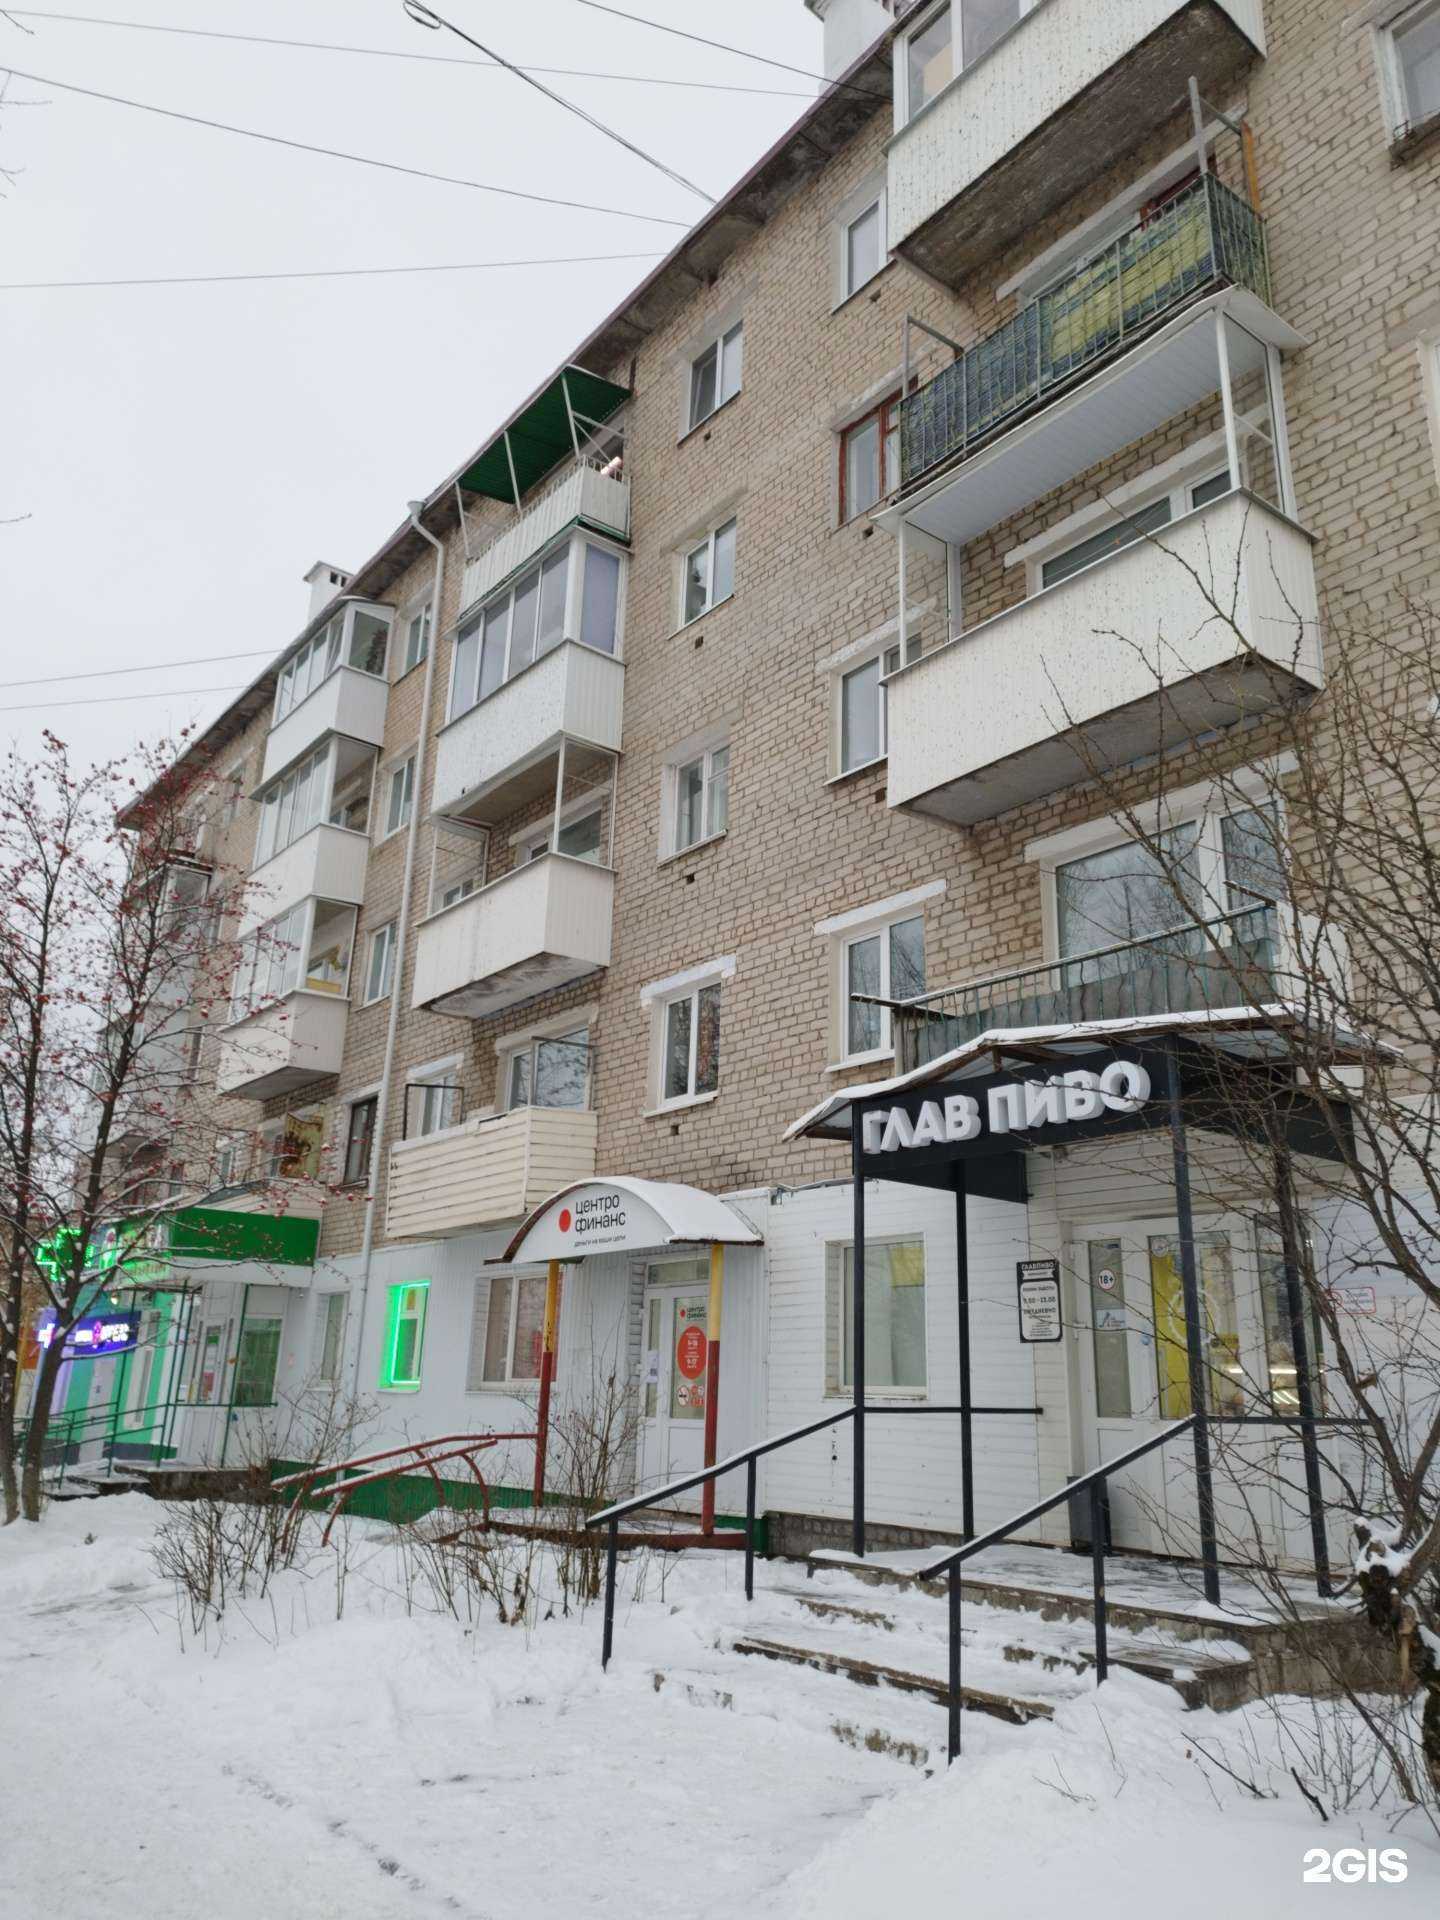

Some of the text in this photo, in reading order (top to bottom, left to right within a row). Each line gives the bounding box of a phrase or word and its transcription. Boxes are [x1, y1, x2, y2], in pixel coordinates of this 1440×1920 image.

[862, 1060, 1151, 1154] ГЛАВ ПИВО
[576, 1194, 619, 1214] центро
[575, 1212, 626, 1235] финанс
[1100, 1275, 1114, 1284] 18+
